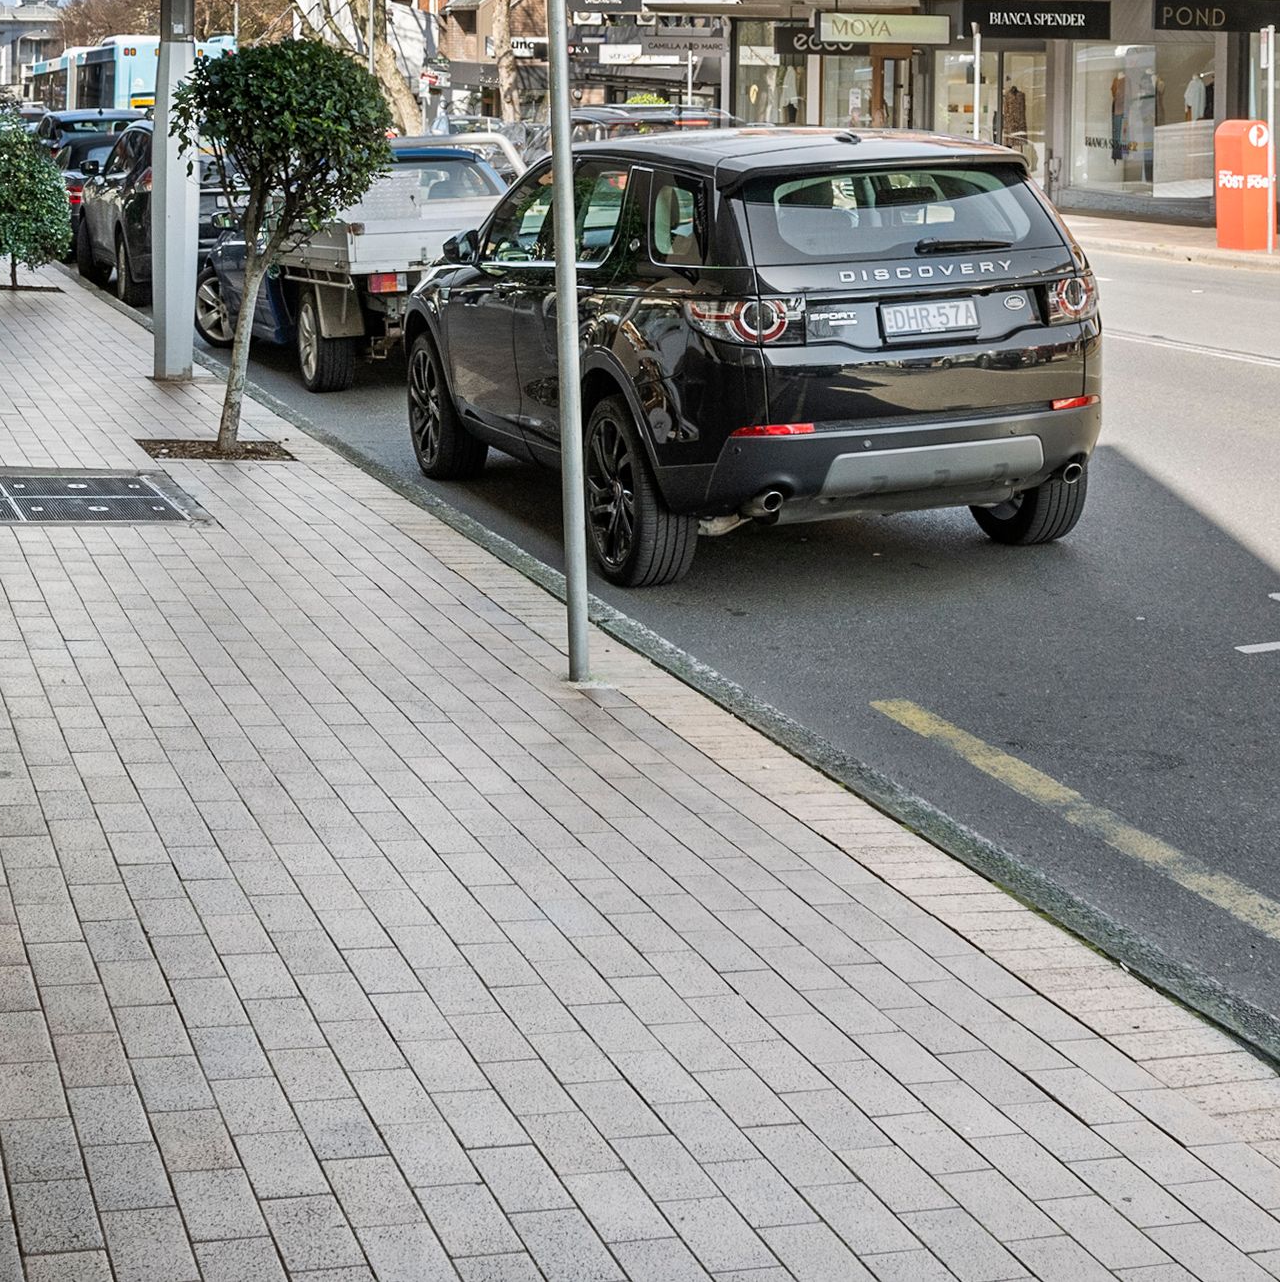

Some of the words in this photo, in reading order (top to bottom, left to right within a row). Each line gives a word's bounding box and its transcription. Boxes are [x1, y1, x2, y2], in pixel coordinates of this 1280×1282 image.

[989, 11, 1032, 25] BIANCA
[1033, 12, 1085, 26] SPENDER
[1162, 6, 1226, 26] POND
[831, 19, 892, 36] MOYA
[648, 42, 680, 51] CAMILLA
[683, 43, 699, 51] AD
[702, 43, 723, 51] MARC
[1218, 174, 1244, 189] POST
[839, 260, 1012, 282] DISCOVERY
[810, 311, 857, 321] SPORT
